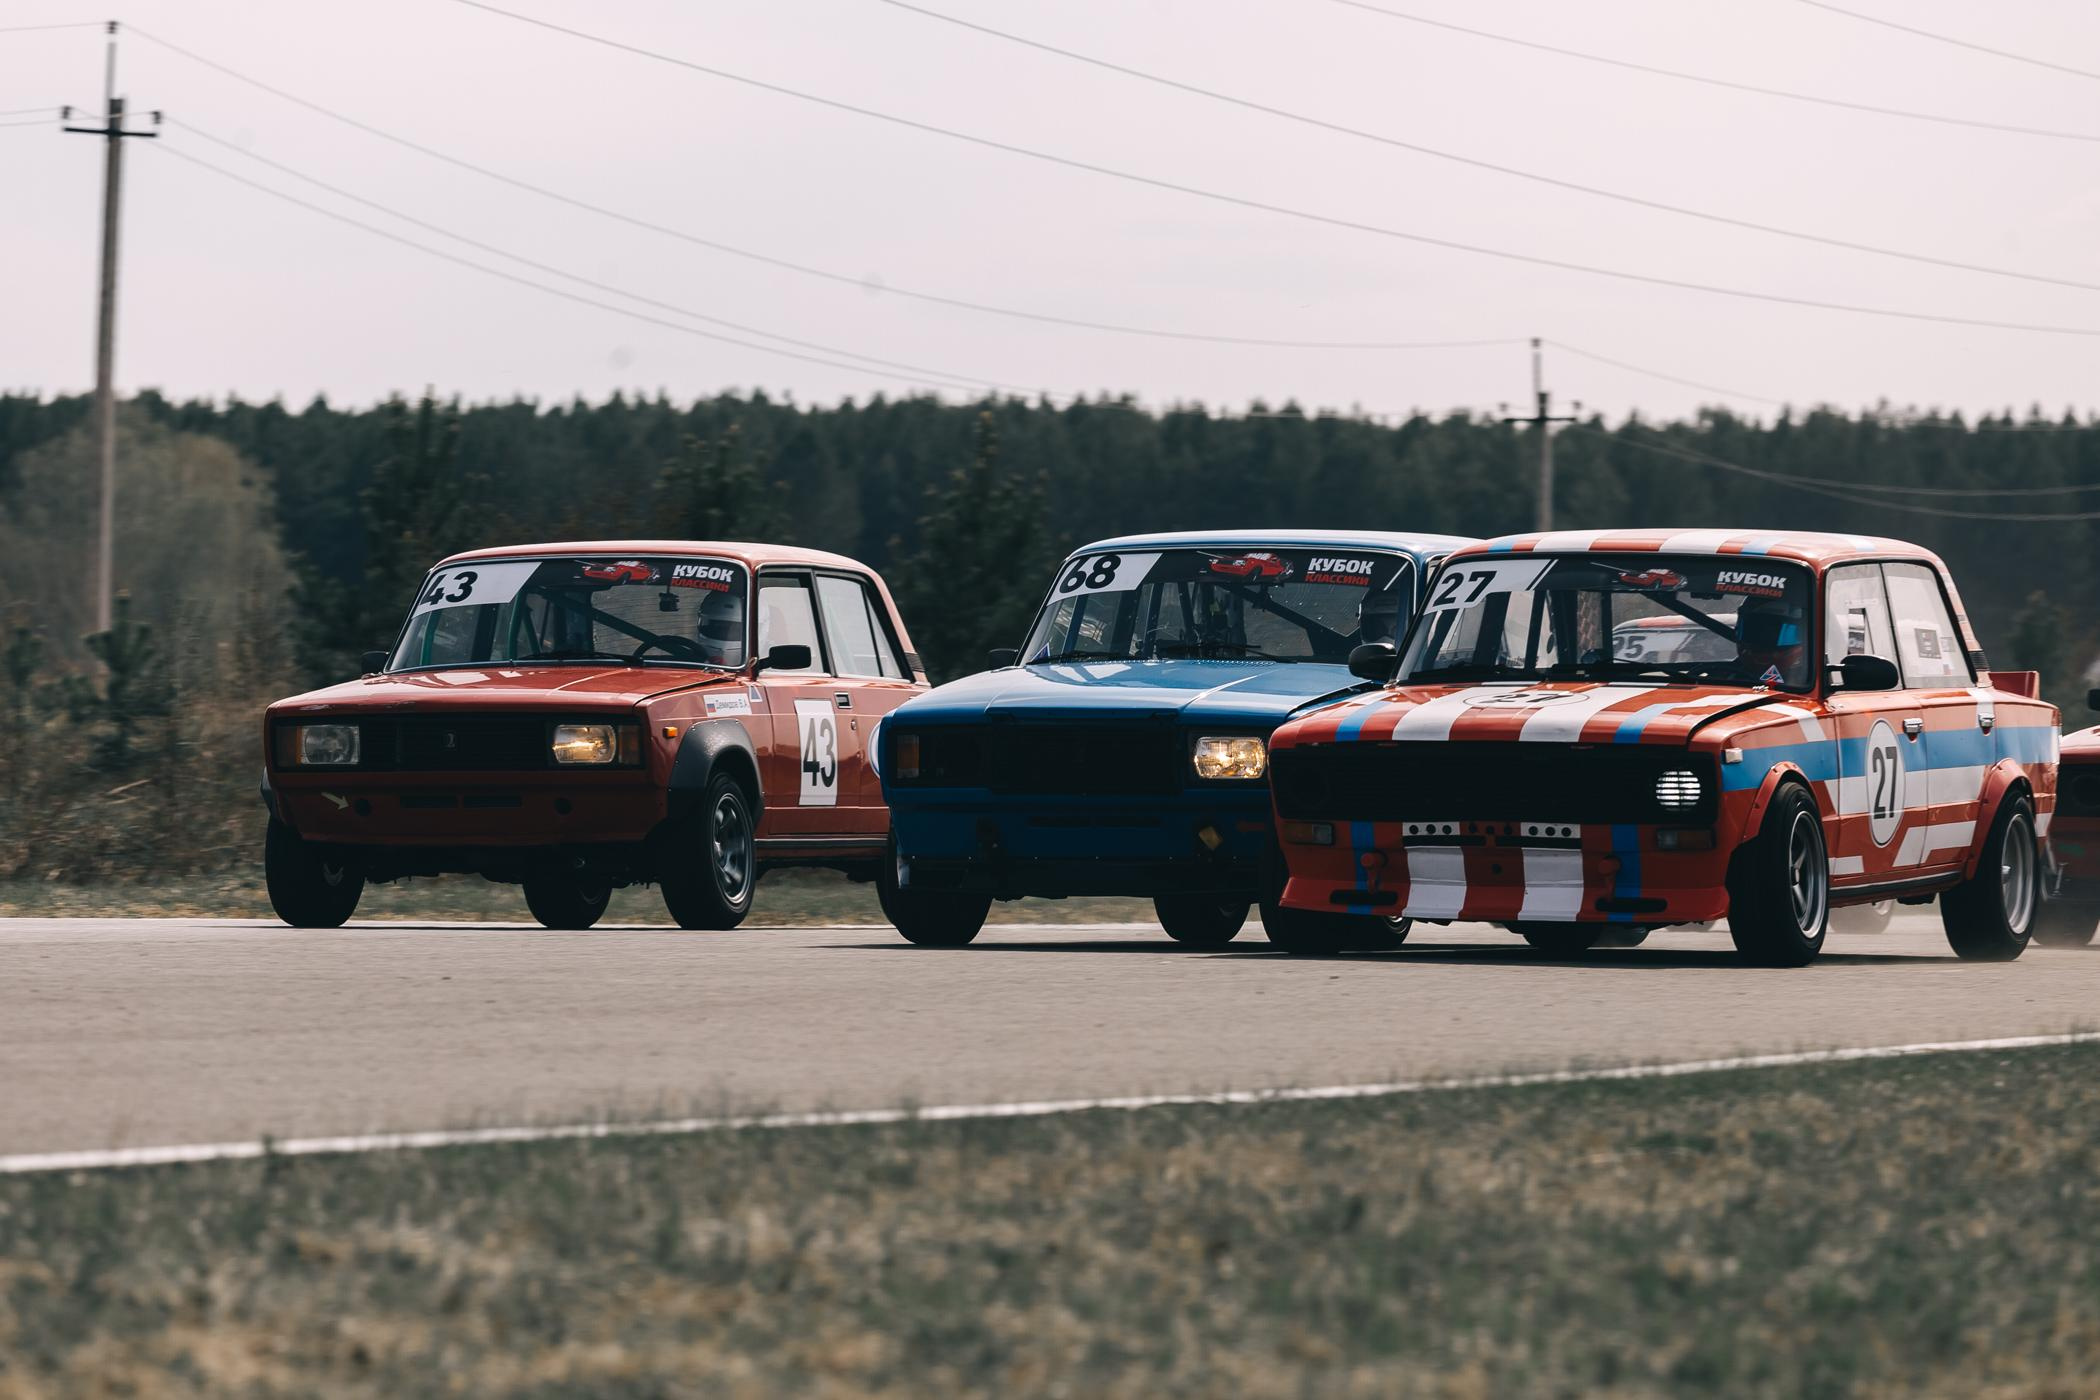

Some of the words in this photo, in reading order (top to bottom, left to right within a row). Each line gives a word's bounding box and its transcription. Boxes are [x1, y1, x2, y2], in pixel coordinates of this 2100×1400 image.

[673, 565, 734, 582] КУБОК
[1059, 555, 1121, 593] 68
[1308, 558, 1374, 574] КУБОК
[420, 571, 478, 605] 43
[672, 577, 729, 592] КЛАССИКИ
[1306, 573, 1369, 587] КЛАССИКИ
[1717, 571, 1786, 588] КУБОК
[1432, 571, 1497, 607] 27
[1716, 583, 1782, 597] КЛАССИКИ
[1478, 694, 1573, 703] 27
[803, 718, 836, 787] 43
[1872, 746, 1897, 819] 27
